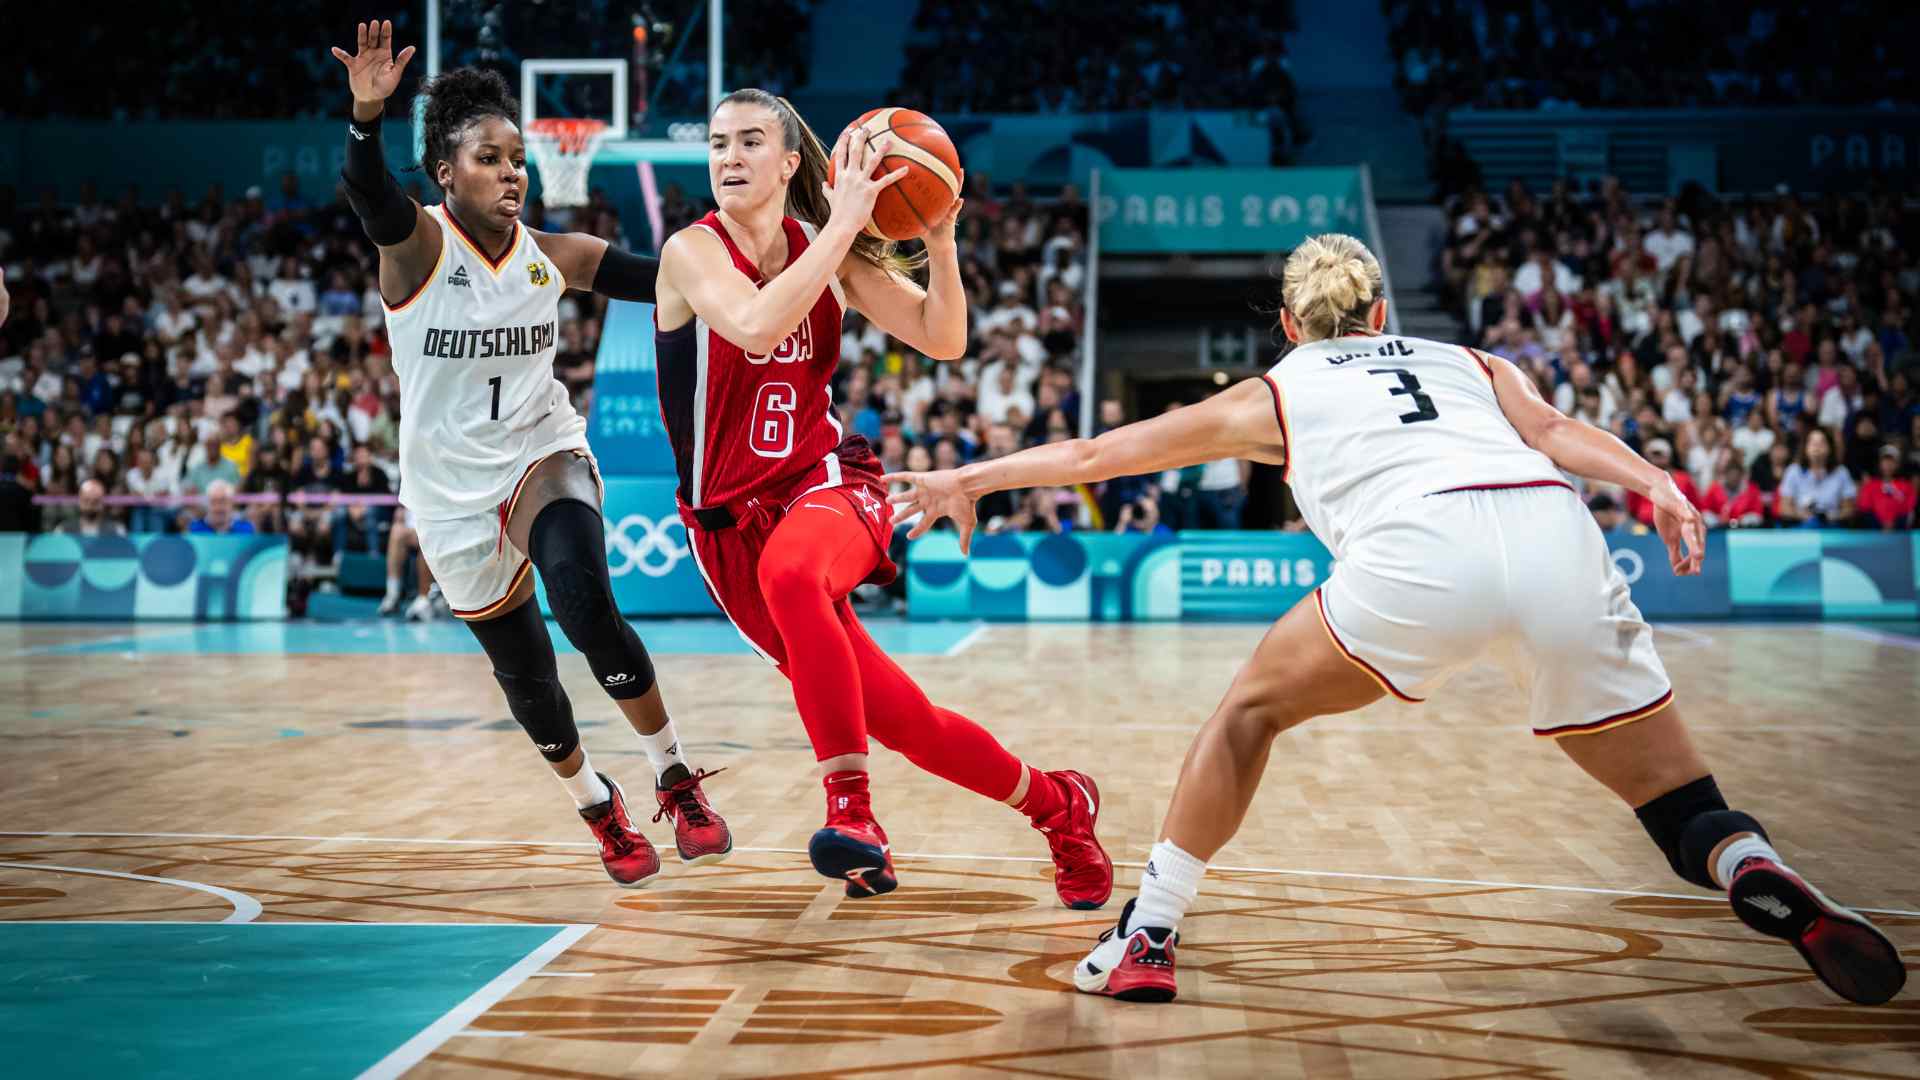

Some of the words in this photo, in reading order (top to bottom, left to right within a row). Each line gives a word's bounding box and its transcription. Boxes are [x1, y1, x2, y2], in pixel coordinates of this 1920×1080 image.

[1094, 195, 1224, 226] PARIS
[448, 276, 472, 288] PEAK
[744, 314, 814, 365] SA
[488, 376, 502, 421] 1
[1366, 369, 1440, 424] 3
[749, 382, 797, 459] 6
[1202, 558, 1316, 588] PARIS
